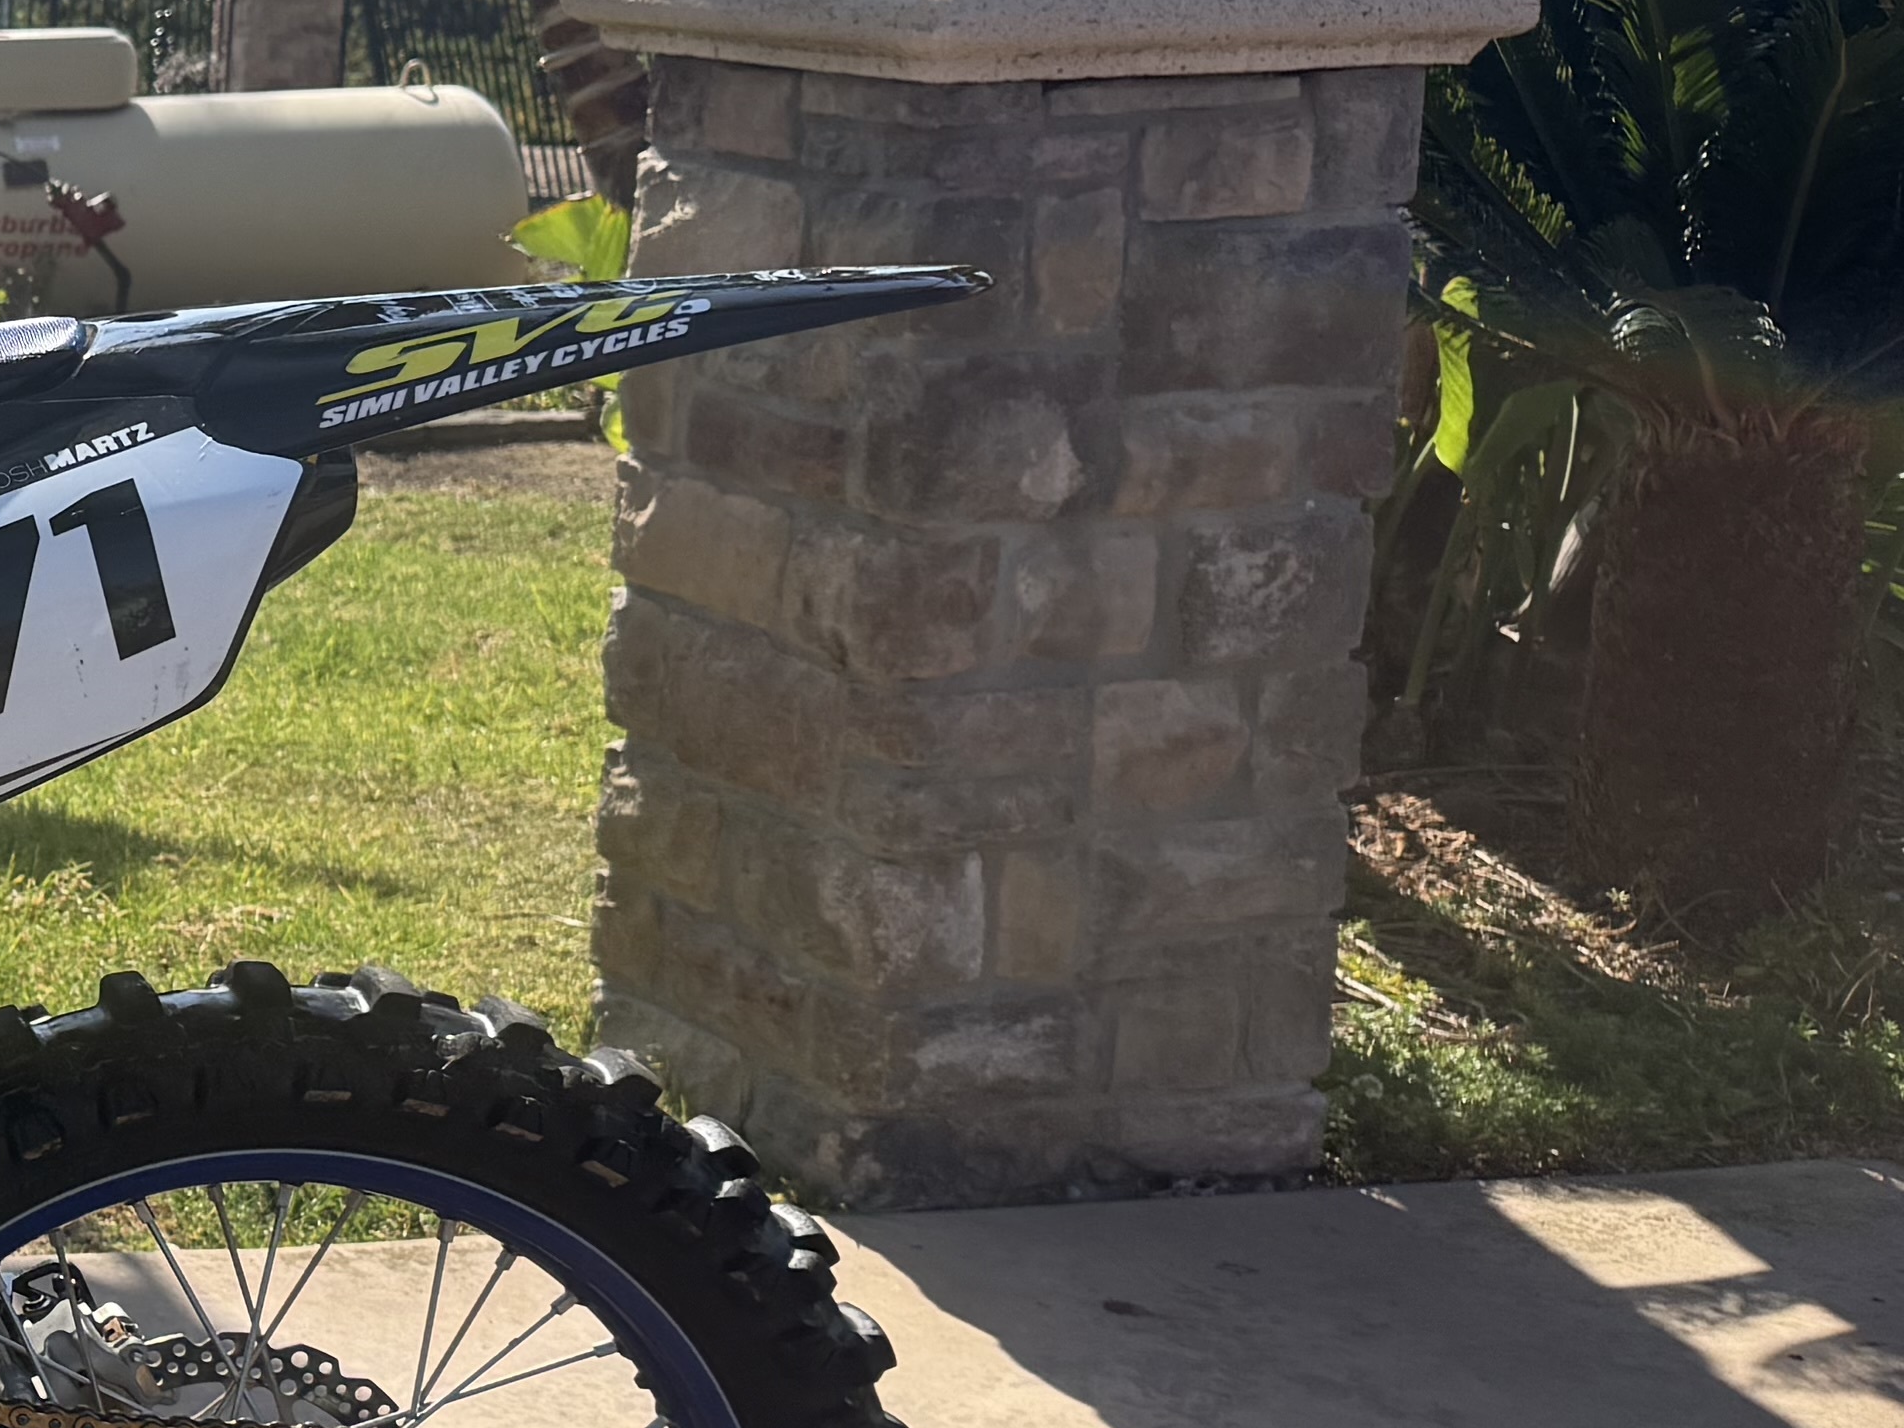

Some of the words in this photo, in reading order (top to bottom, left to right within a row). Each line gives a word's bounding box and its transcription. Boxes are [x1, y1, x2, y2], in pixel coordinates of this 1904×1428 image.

[319, 389, 407, 430] SIMI
[414, 350, 553, 404] VALLEY
[550, 316, 691, 369] CYCLES
